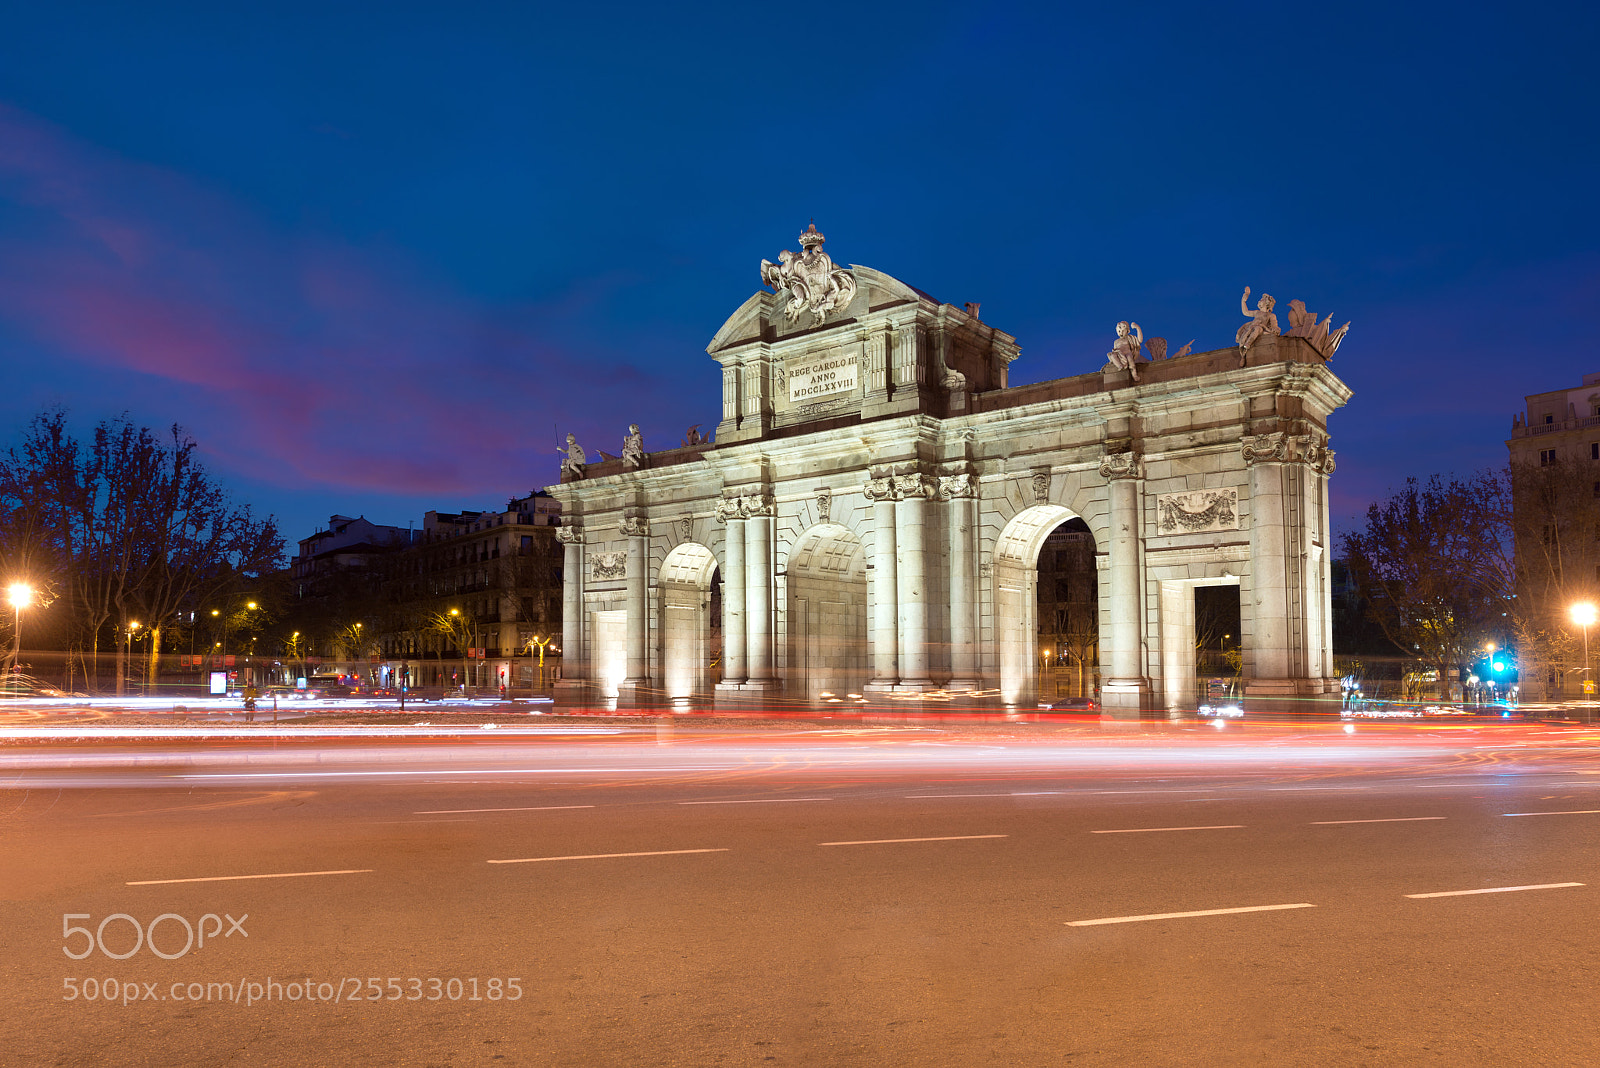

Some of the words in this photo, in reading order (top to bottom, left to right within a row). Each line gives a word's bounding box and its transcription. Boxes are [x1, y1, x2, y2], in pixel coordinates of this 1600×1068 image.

[789, 367, 811, 378] REGE
[812, 359, 846, 373] CAROLO
[848, 356, 858, 365] III
[793, 378, 853, 398] MDCCLXXVIII
[810, 372, 836, 384] ANNO
